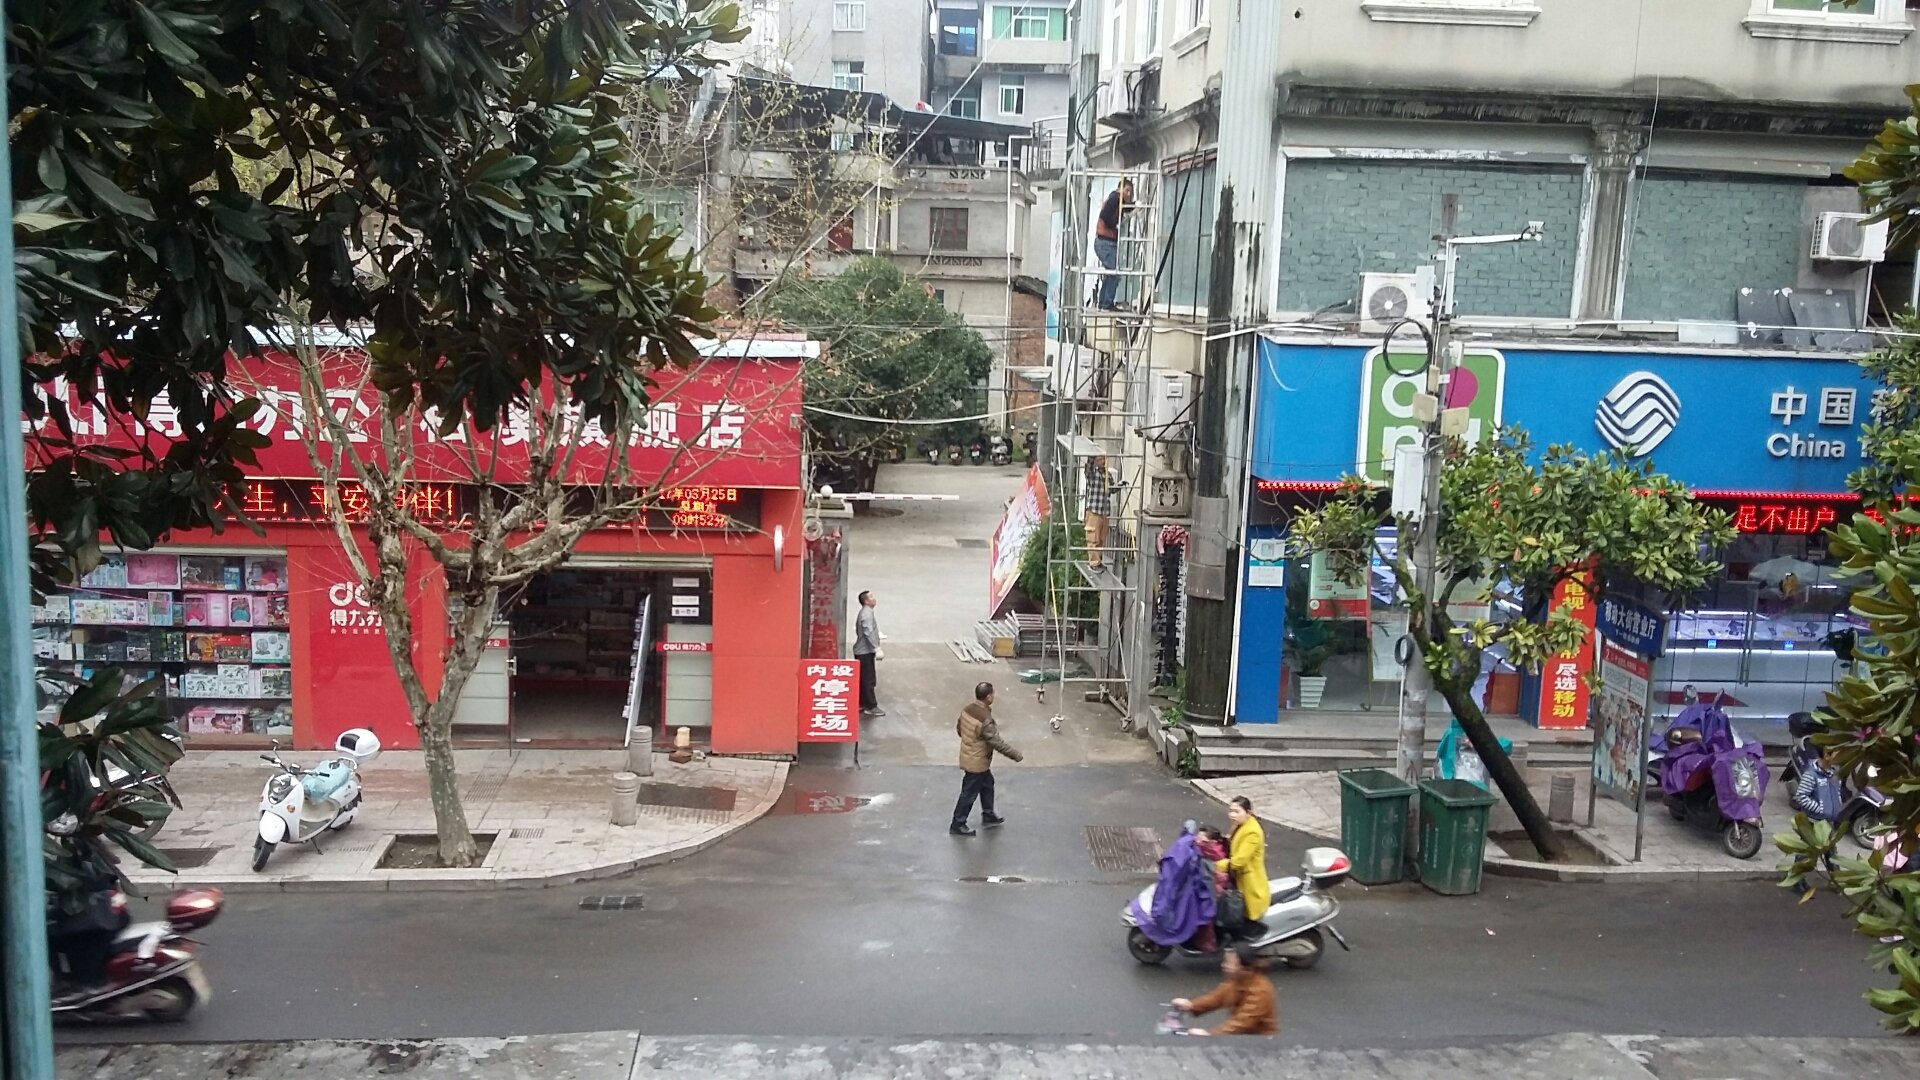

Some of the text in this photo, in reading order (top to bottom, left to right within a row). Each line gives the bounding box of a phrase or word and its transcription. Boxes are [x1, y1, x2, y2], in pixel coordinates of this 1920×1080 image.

[1766, 433, 1846, 459] China
[1735, 504, 1837, 533] 足不出户
[806, 664, 854, 677] 内设
[810, 678, 850, 732] 停车场
[1552, 662, 1579, 719] 尽选移动
